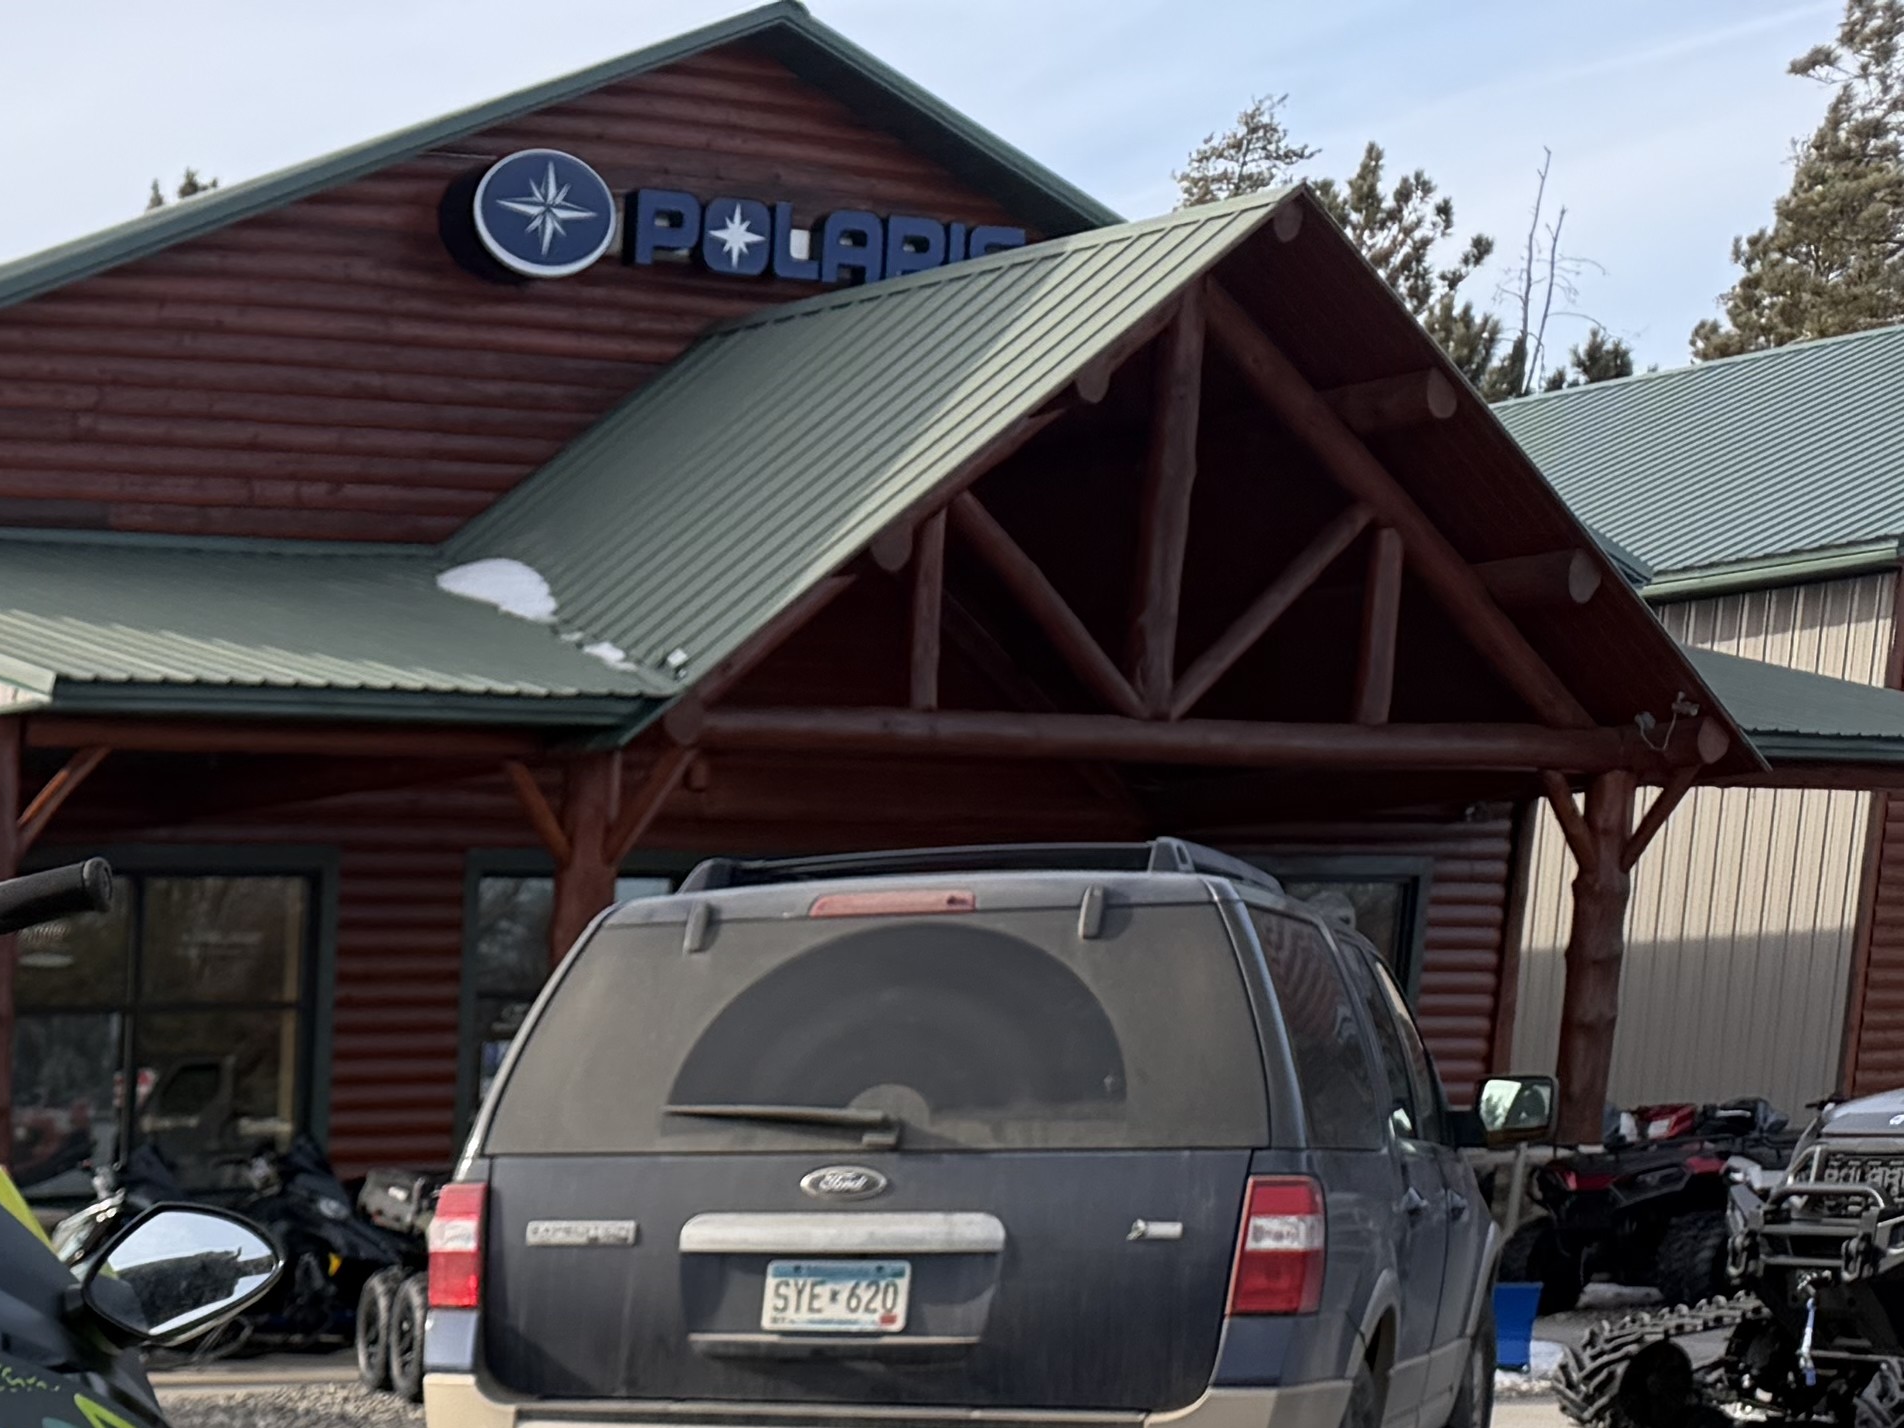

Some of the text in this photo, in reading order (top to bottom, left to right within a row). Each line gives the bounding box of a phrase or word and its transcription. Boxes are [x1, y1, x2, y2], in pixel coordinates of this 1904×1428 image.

[818, 1170, 869, 1192] Ford
[772, 1279, 899, 1313] SYE 620
